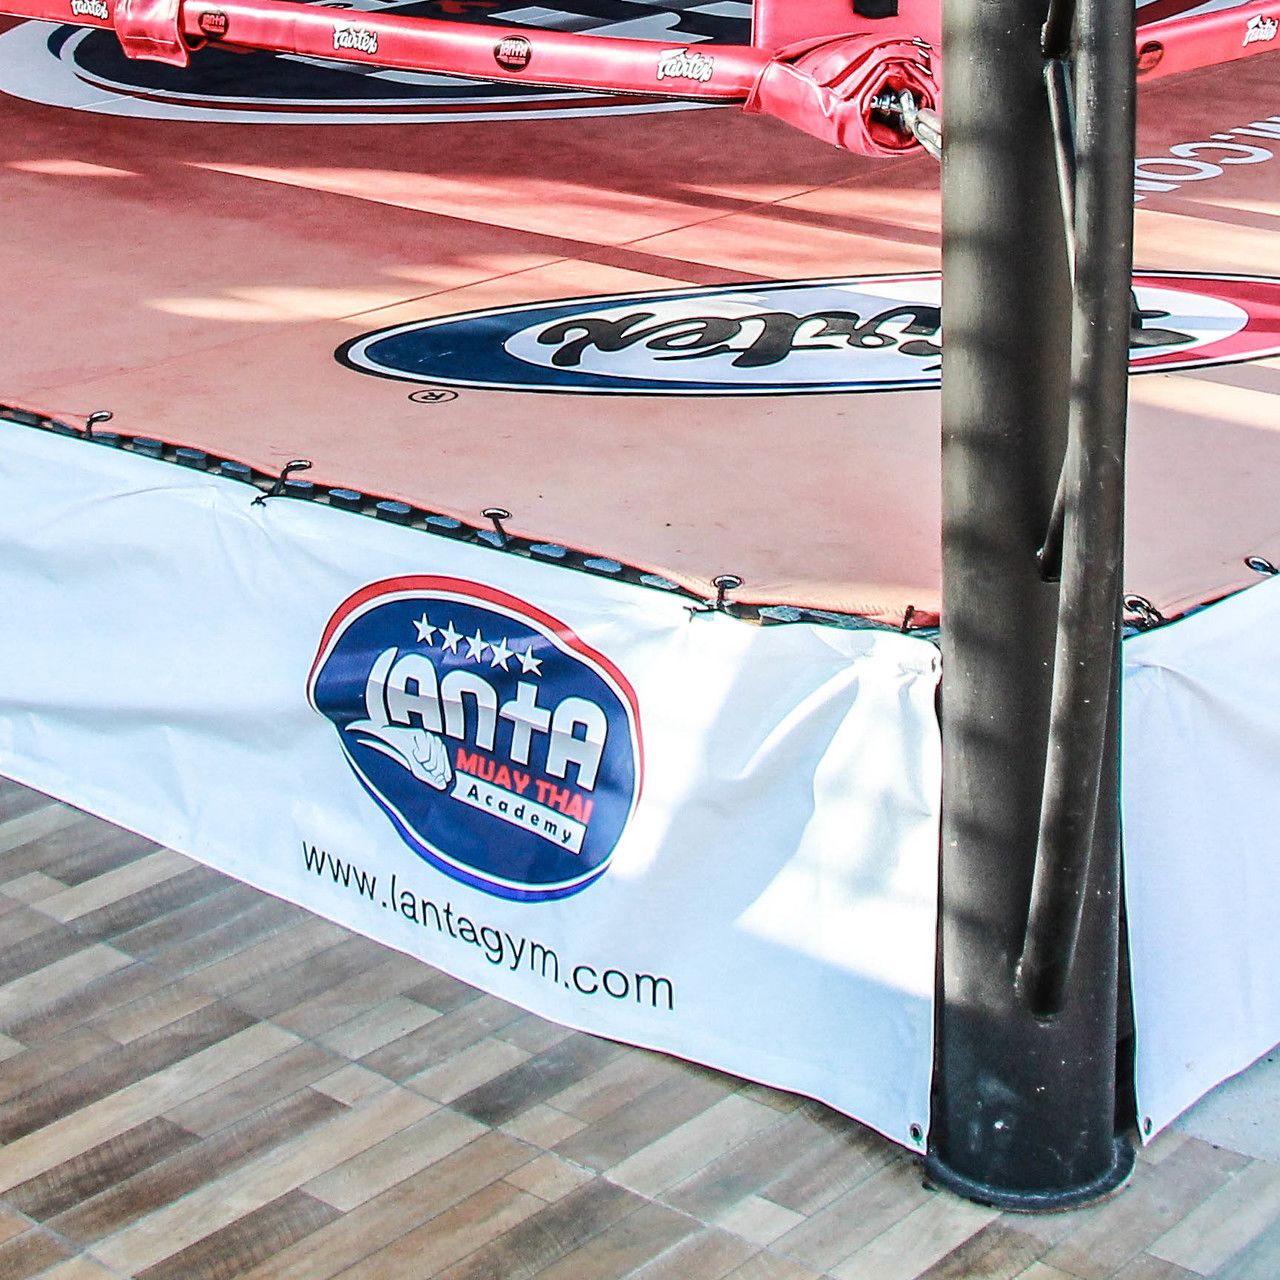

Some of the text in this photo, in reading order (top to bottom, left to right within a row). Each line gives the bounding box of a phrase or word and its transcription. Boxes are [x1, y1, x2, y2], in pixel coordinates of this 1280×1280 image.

[332, 24, 378, 54] Fairtex
[656, 48, 715, 82] Fairtex
[455, 746, 595, 825] MUAY THAI
[466, 783, 573, 845] Academy
[301, 839, 675, 1011] www.lantagym.com
